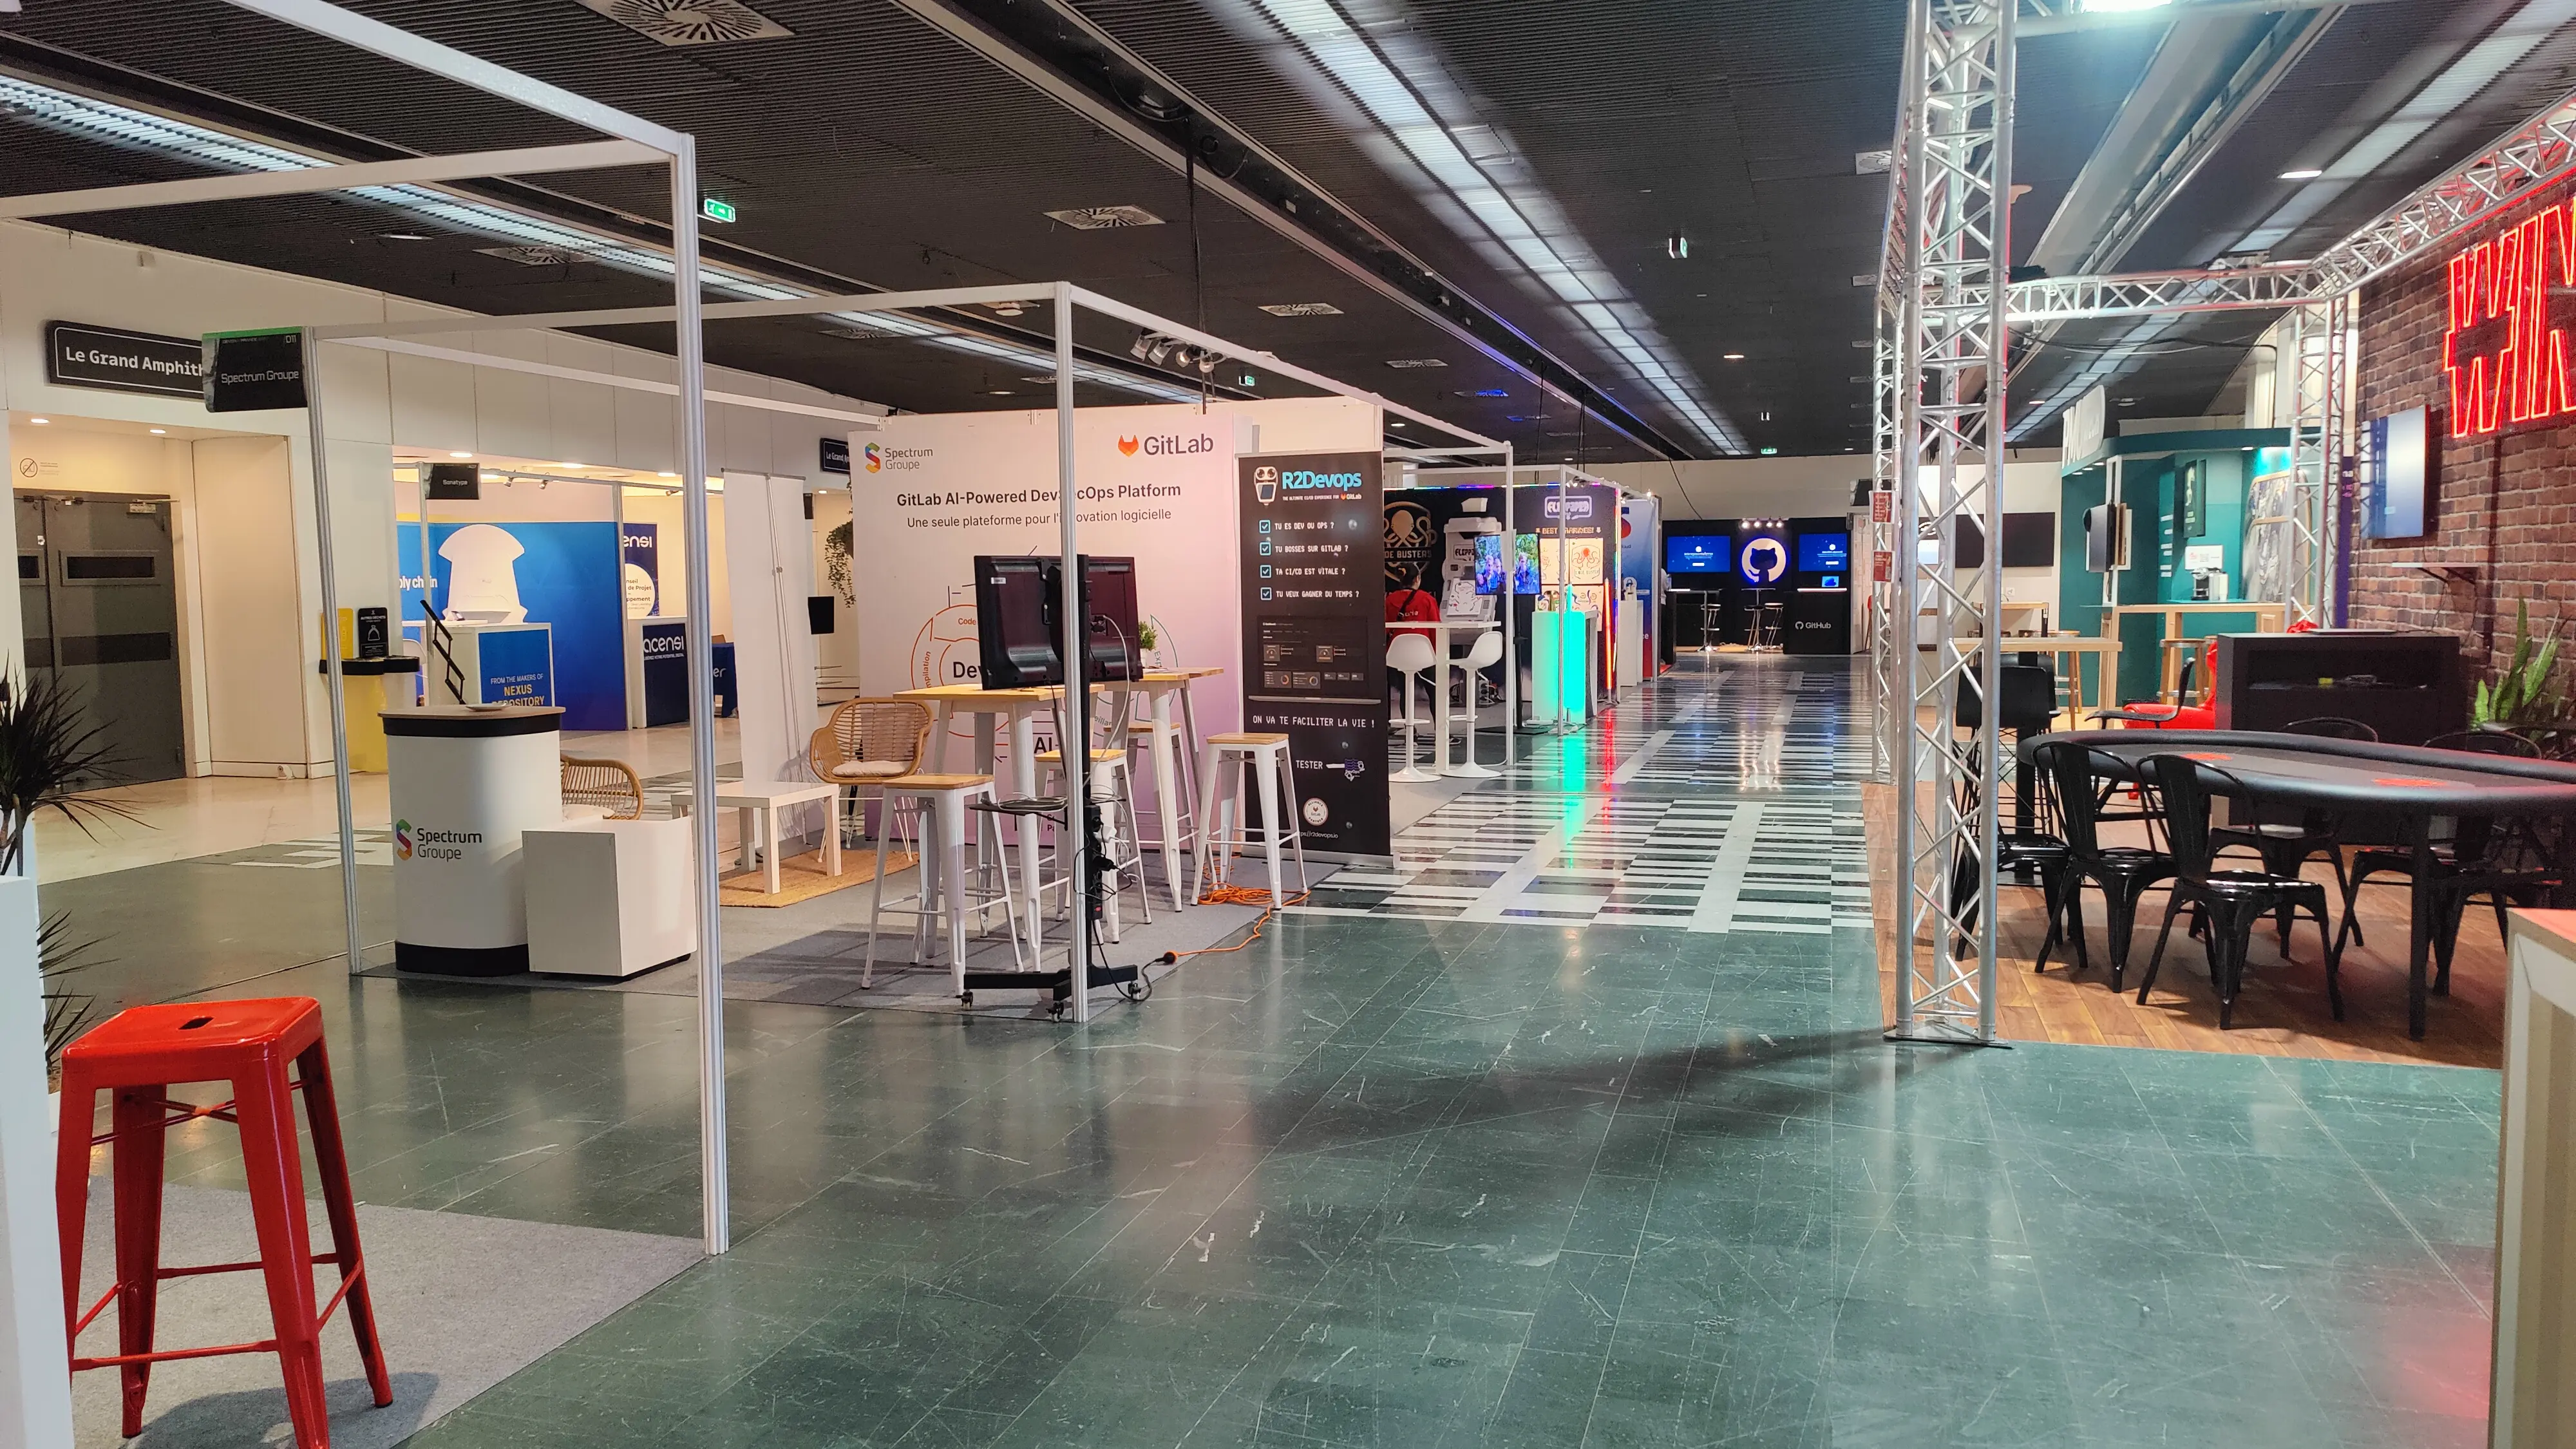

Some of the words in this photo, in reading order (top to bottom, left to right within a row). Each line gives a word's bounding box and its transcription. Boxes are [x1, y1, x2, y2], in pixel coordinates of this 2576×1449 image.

[66, 346, 85, 363] Le
[90, 350, 138, 370] Grand
[221, 373, 265, 386] Spectrum
[266, 370, 299, 382] Groupe
[1144, 433, 1214, 456] GitLab
[831, 451, 844, 462] Grand
[884, 448, 933, 460] Spectrum
[885, 459, 920, 471] Groupe
[1282, 471, 1362, 491] R2Devops
[897, 493, 942, 506] GitLab
[945, 490, 1027, 505] AI-Powered
[1031, 486, 1114, 502] DevcOps
[1118, 484, 1181, 498] Platform
[907, 517, 929, 527] Une
[931, 516, 960, 527] seule
[963, 515, 1022, 529] plateforme
[1025, 516, 1050, 527] pour
[1054, 510, 1117, 524] l'iovation
[1121, 509, 1172, 523] logicielle
[1397, 550, 1432, 558] BUSTERS
[412, 575, 438, 589] chin
[490, 677, 506, 685] FROM
[516, 674, 536, 682] MAKERS
[504, 684, 533, 696] NEXUS
[1253, 715, 1262, 724] ON
[1265, 715, 1276, 724] VA
[1279, 716, 1289, 725] TE
[1293, 717, 1334, 726] FACILITER
[1338, 718, 1348, 727] LA
[1352, 719, 1366, 728] VIE
[1371, 719, 1374, 728] !
[1296, 760, 1323, 770] TESTER
[417, 828, 482, 845] Spectrum
[1299, 830, 1339, 839] ps://r2devops.io
[417, 844, 462, 862] Groupe
